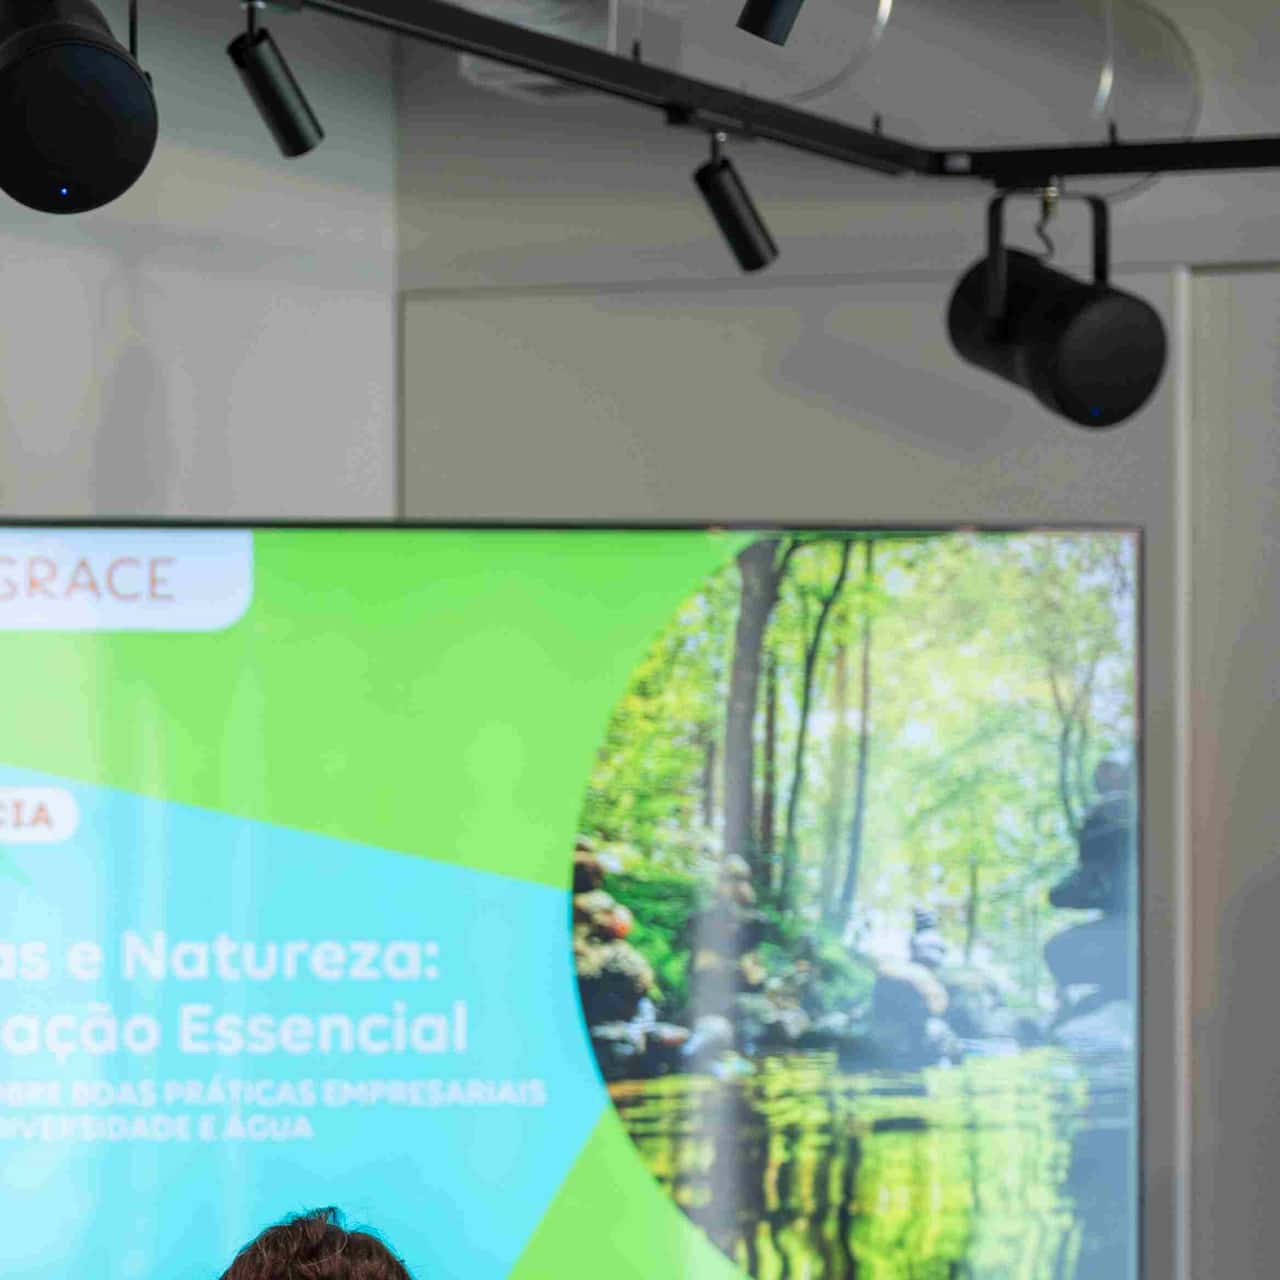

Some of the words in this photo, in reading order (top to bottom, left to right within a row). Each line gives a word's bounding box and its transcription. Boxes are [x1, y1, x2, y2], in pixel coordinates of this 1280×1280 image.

[66, 940, 103, 980] e
[121, 930, 440, 981] Natureza:
[180, 1001, 468, 1055] Essencial
[71, 1080, 156, 1107] BOAS
[164, 1073, 316, 1106] PRÁTICAS
[323, 1078, 547, 1106] EMPRESARIAIS
[200, 1114, 218, 1141] E
[224, 1106, 314, 1141] ÁGUA
